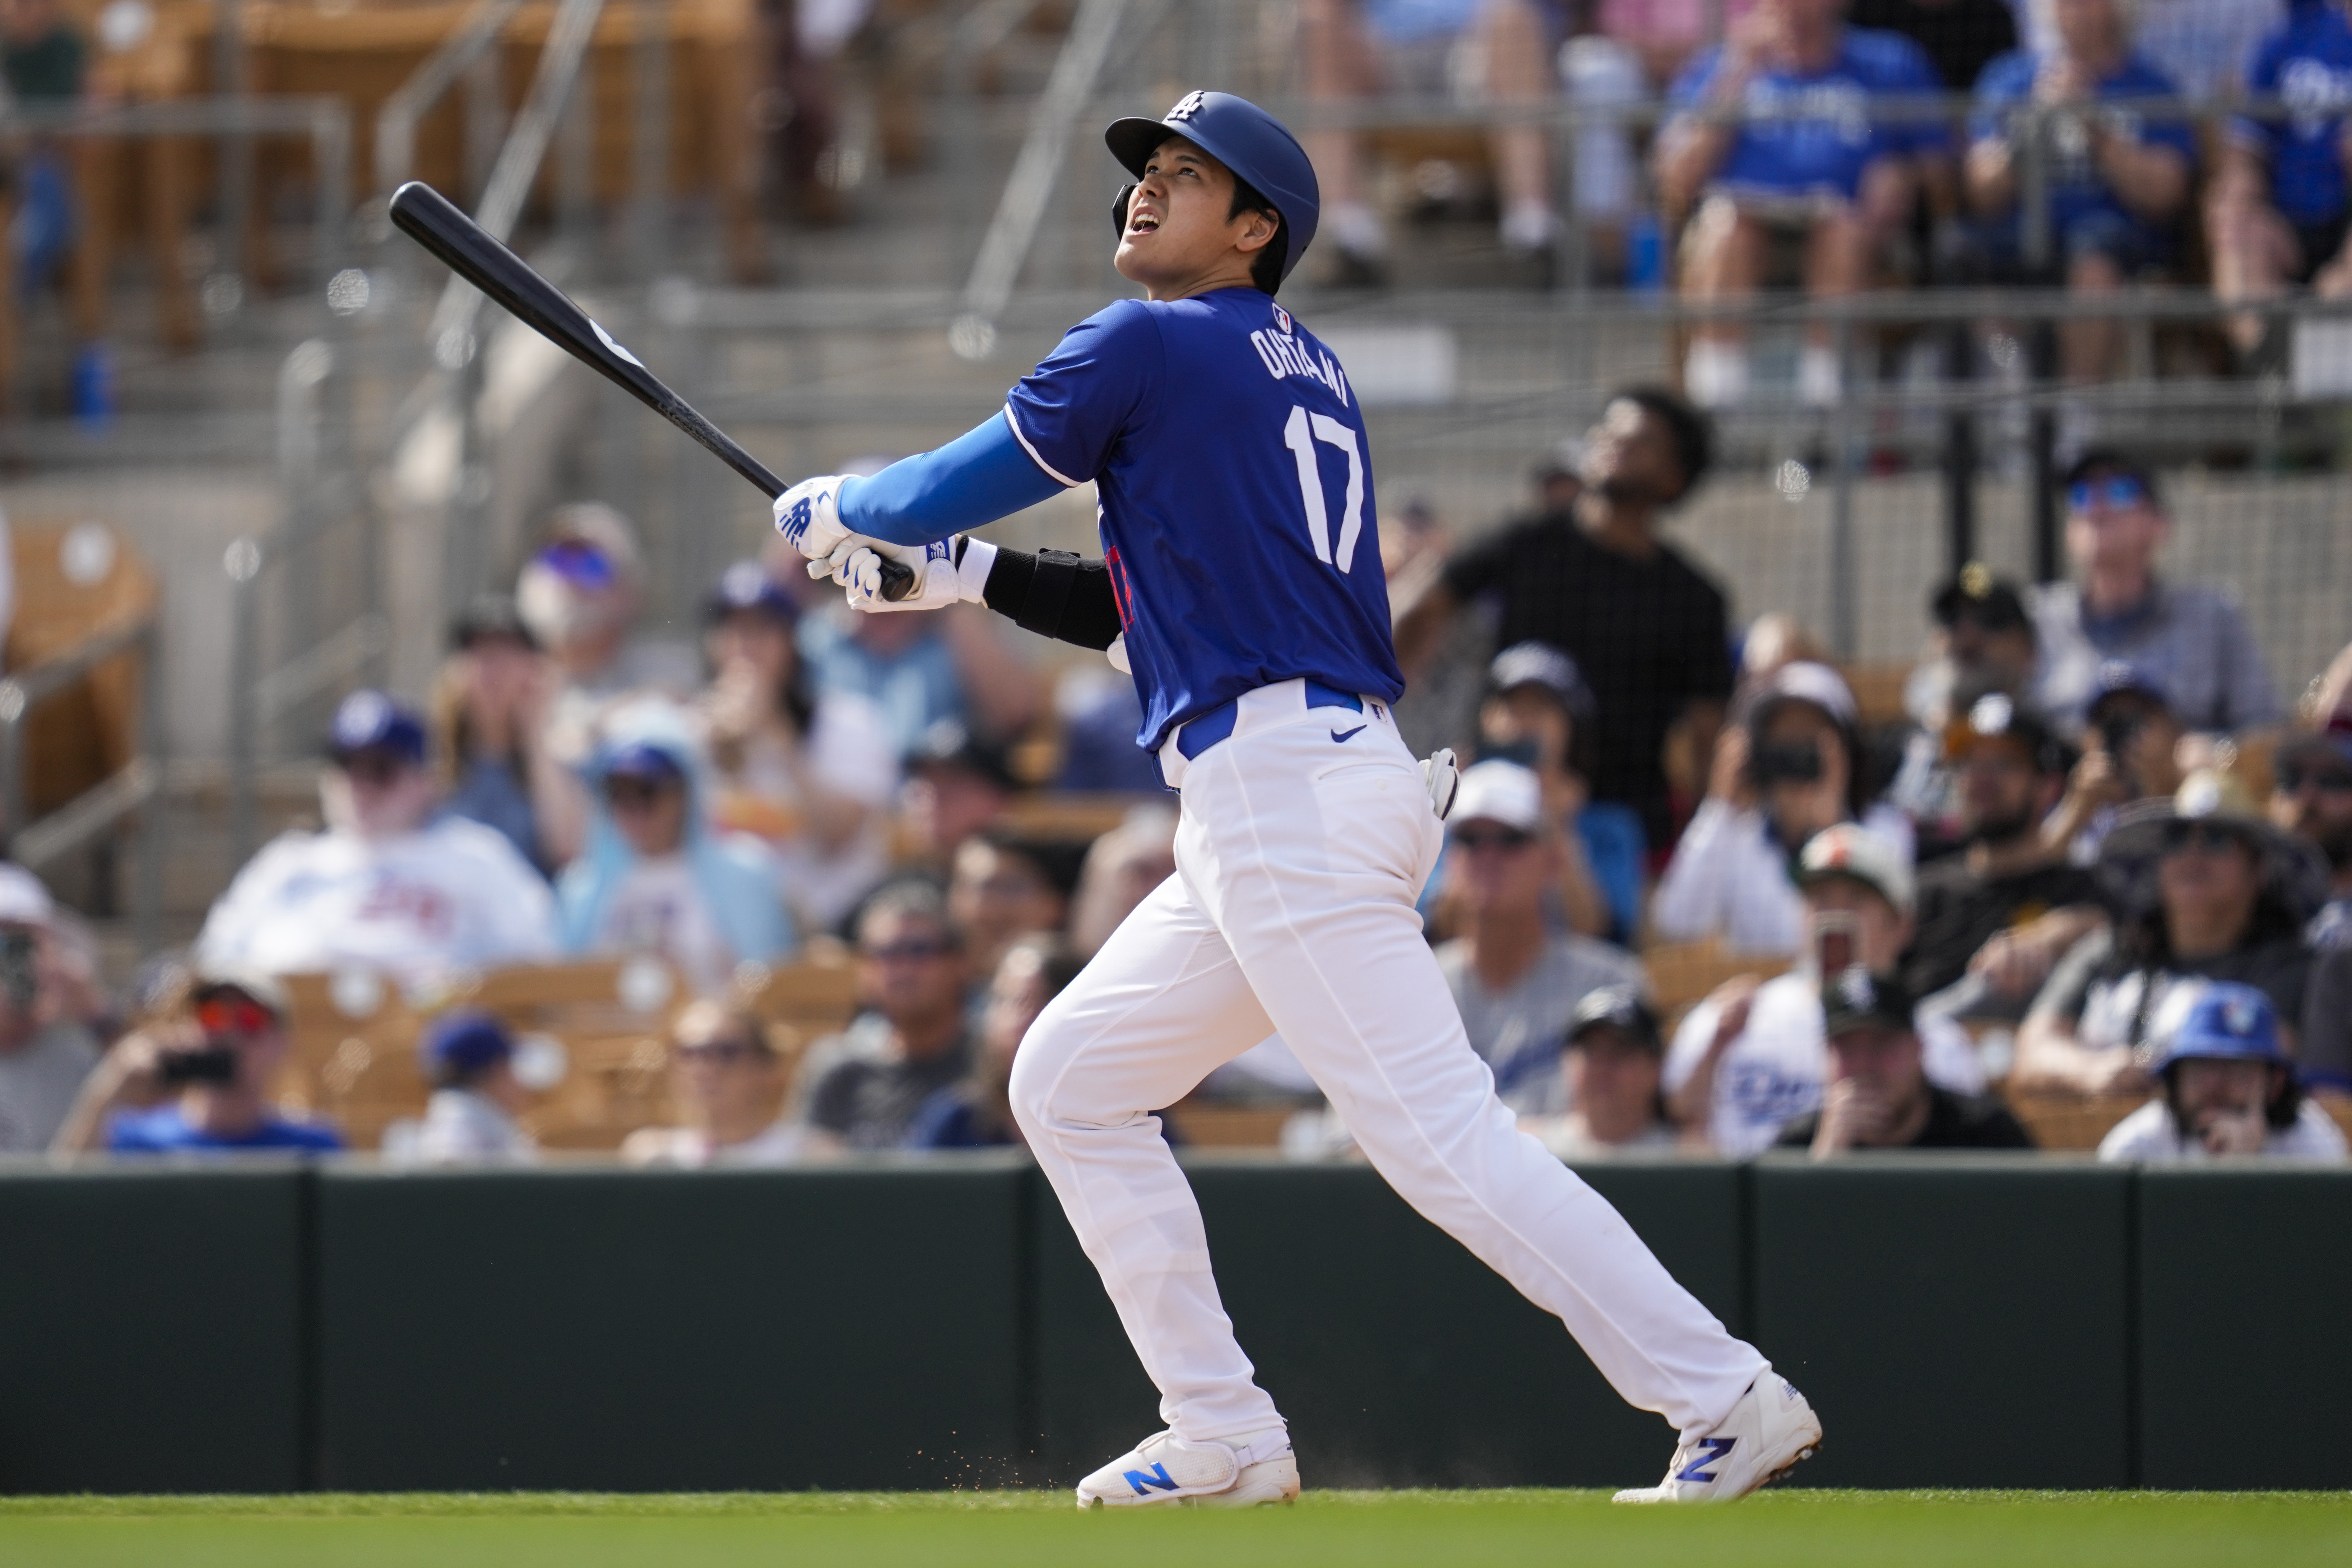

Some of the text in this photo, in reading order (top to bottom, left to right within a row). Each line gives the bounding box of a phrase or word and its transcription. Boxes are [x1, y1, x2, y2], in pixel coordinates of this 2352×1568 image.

[1167, 90, 1204, 121] LA
[1250, 328, 1349, 408] OHTANI
[1284, 405, 1364, 574] 17
[1123, 1461, 1181, 1496] N
[1675, 1438, 1738, 1483] N
